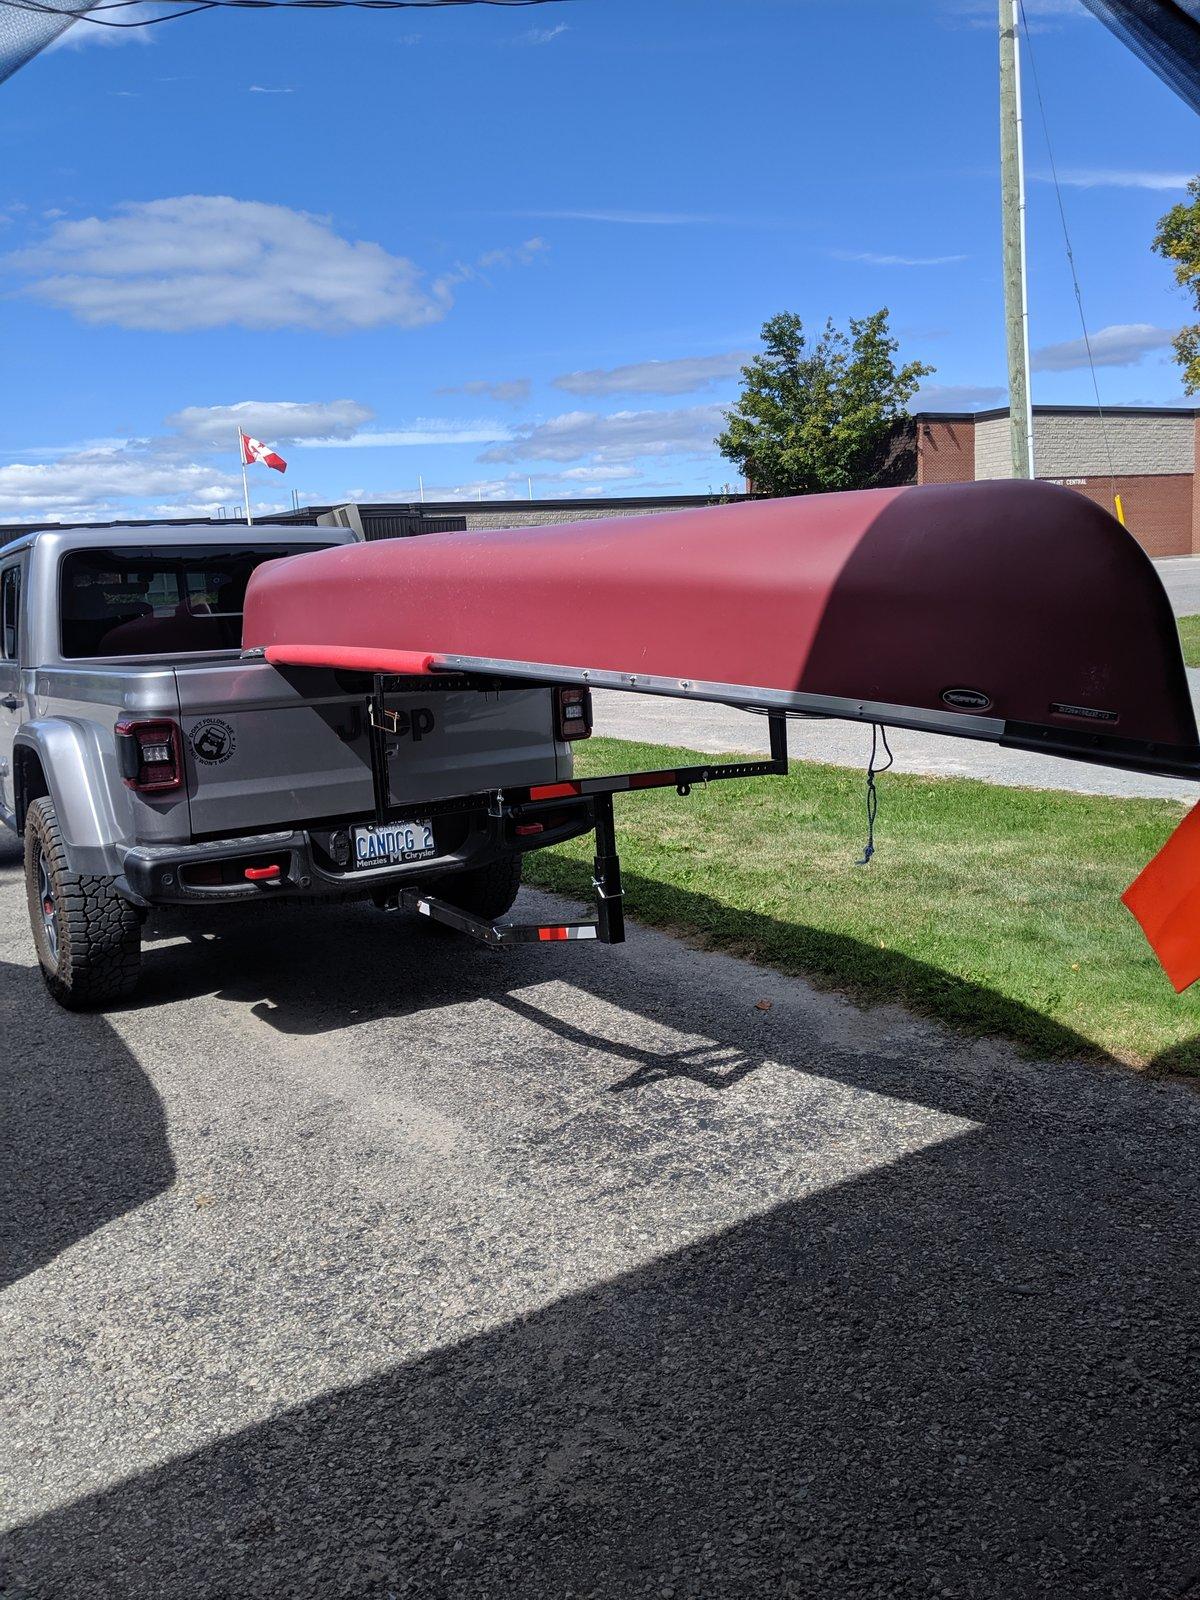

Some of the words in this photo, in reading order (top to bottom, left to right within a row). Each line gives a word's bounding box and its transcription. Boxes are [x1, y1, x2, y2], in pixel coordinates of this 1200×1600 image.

[336, 706, 435, 741] Jep
[423, 826, 434, 848] 2
[356, 857, 388, 868] Menzies
[404, 849, 436, 860] Chrysler
